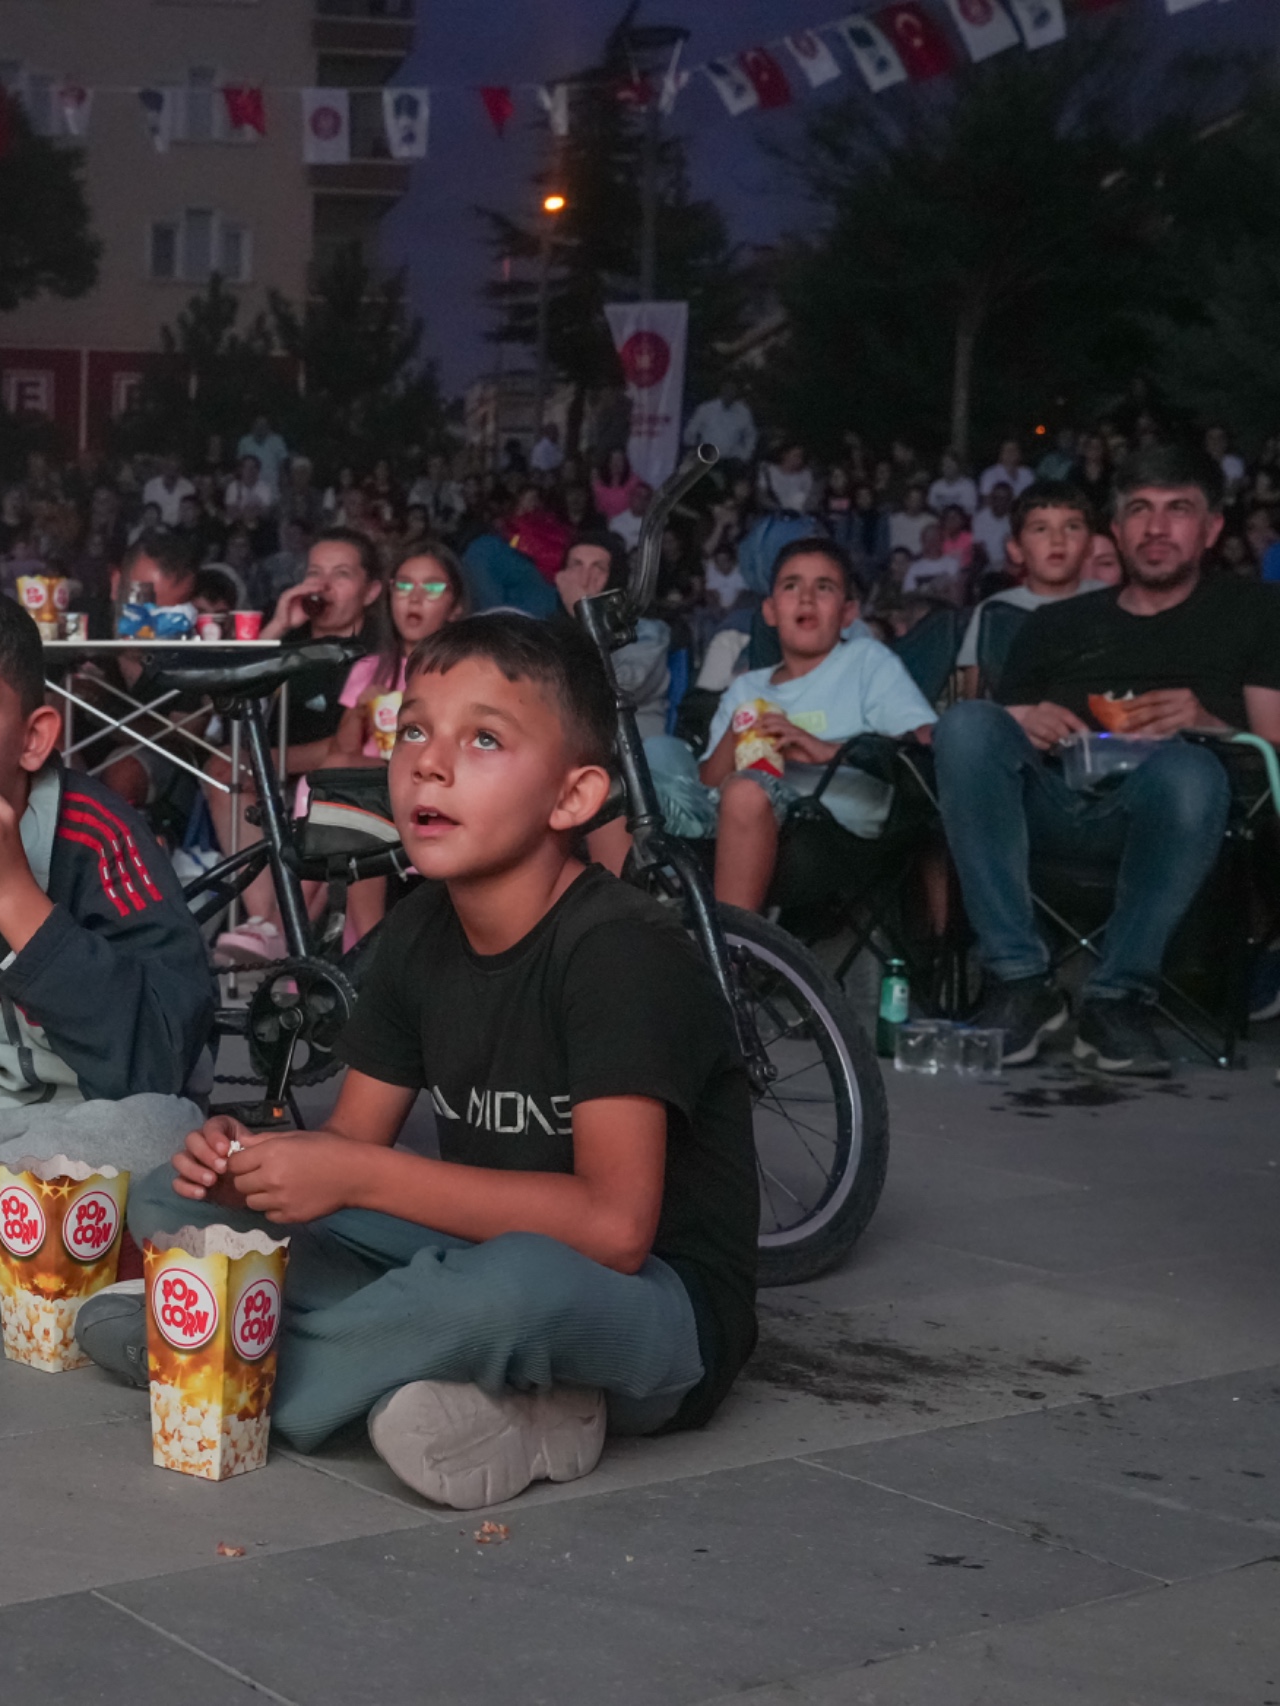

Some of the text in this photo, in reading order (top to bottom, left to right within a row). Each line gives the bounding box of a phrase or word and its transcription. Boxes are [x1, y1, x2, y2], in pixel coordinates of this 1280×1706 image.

[1, 1195, 29, 1222] POP
[76, 1200, 107, 1226] POP
[4, 1219, 38, 1245] CORN
[73, 1222, 112, 1249] CORN
[162, 1278, 199, 1311] POP
[244, 1289, 272, 1320] POP
[161, 1303, 209, 1337] CORN
[240, 1314, 276, 1346] CORN
